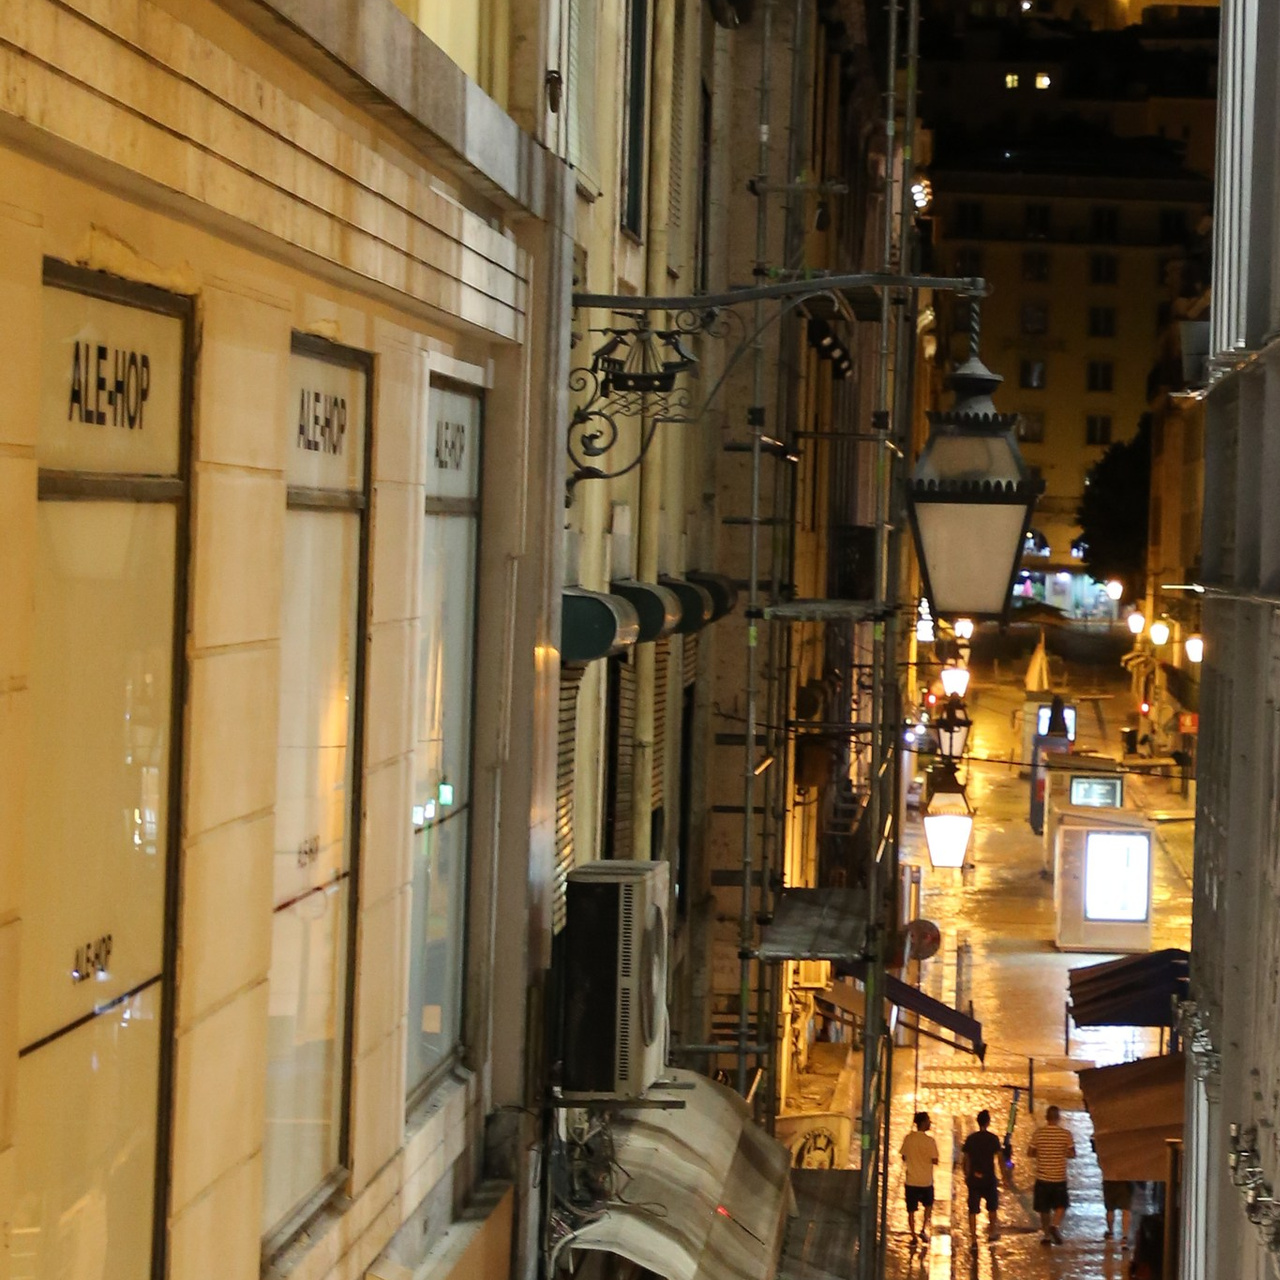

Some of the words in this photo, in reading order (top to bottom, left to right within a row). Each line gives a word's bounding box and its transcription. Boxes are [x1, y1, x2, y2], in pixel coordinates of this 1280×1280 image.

[68, 340, 151, 430] ALE-HOP
[298, 387, 348, 456] ALE-HOP
[434, 420, 465, 472] ALE-HOP
